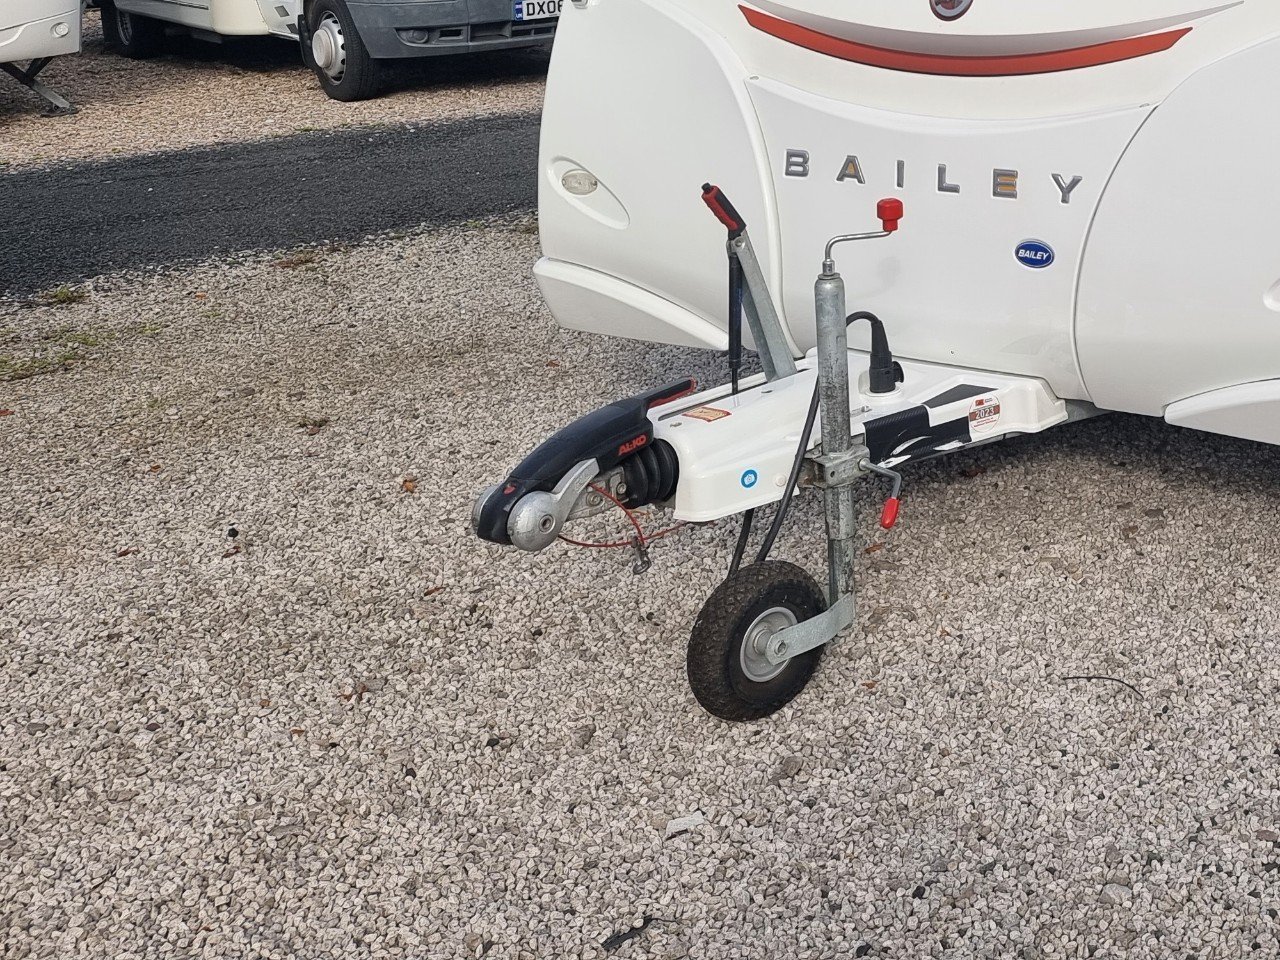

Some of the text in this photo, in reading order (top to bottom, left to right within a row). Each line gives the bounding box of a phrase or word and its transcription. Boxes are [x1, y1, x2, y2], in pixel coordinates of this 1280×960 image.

[784, 148, 1083, 205] BAILEY
[1017, 249, 1050, 261] BAILEY
[975, 407, 995, 420] 2023
